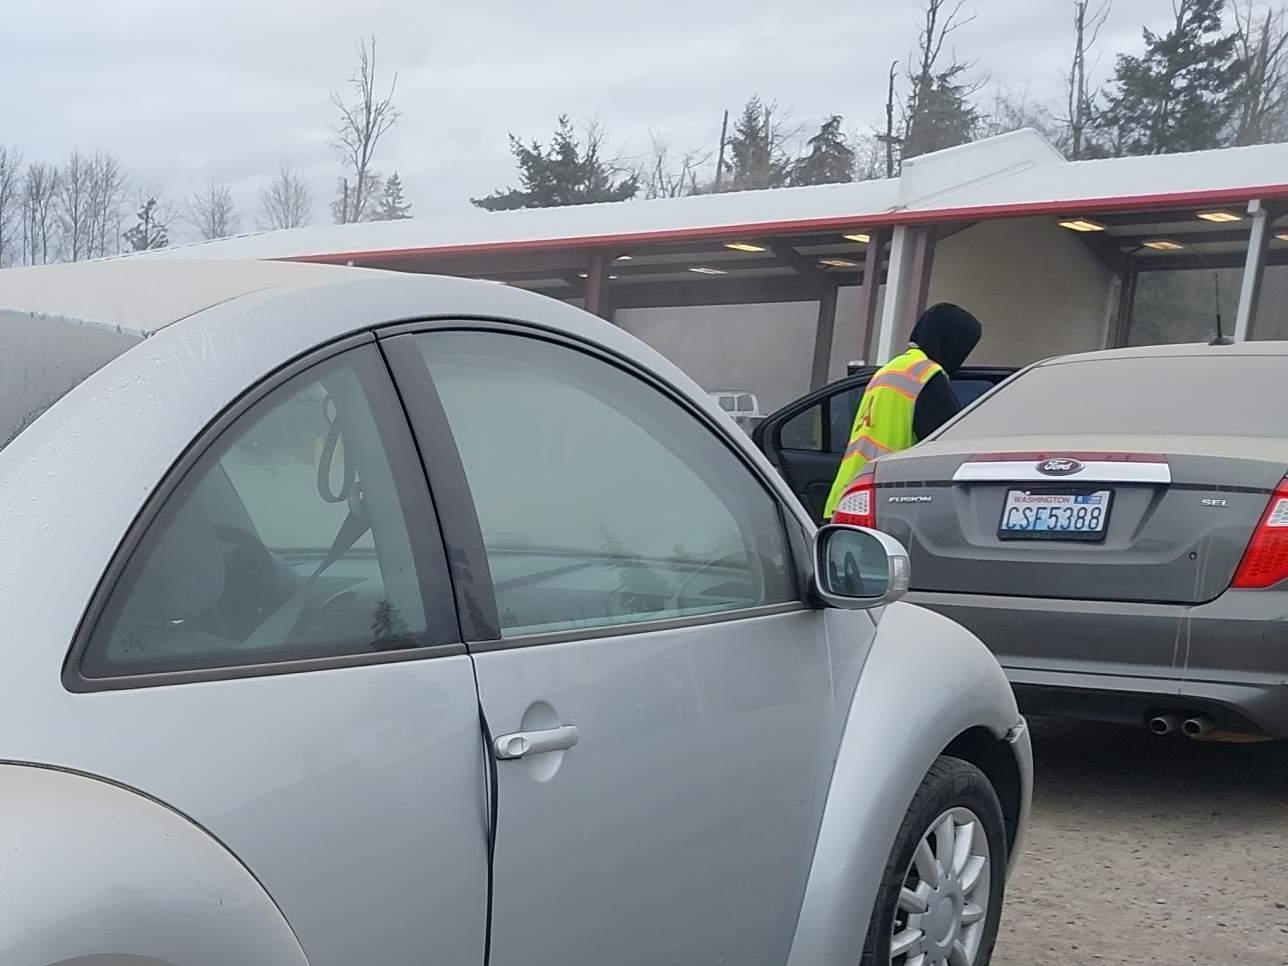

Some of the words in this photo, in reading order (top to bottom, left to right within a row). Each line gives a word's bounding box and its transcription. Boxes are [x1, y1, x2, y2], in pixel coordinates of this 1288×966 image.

[1043, 459, 1073, 471] Ford
[1013, 496, 1071, 504] WASHINGTON
[1200, 498, 1231, 506] SEL
[1005, 506, 1103, 531] CSF5388
